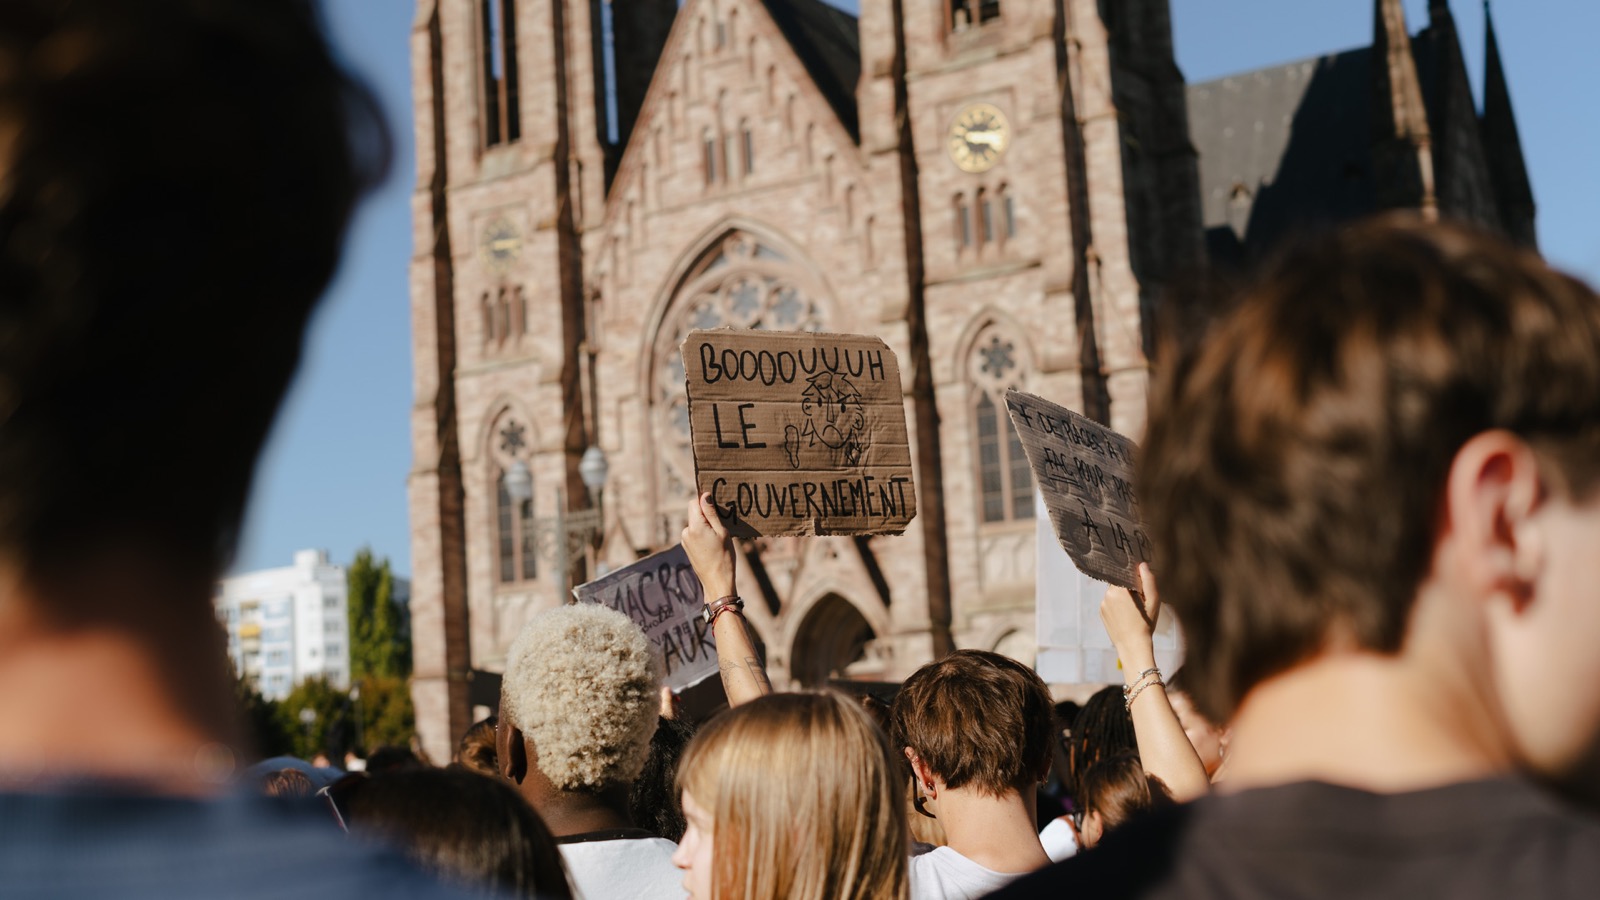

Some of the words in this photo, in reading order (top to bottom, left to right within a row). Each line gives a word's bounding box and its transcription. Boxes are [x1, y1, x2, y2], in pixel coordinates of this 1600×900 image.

[700, 342, 885, 386] BOOOOUUUH
[713, 403, 767, 449] LE
[1037, 411, 1063, 439] DE
[1063, 423, 1105, 456] PLACES
[1043, 446, 1074, 477] FAC
[1073, 456, 1110, 491] POUR
[712, 476, 909, 525] GOUVERNEMENT
[1077, 497, 1105, 547] À
[1108, 517, 1134, 556] LA
[592, 562, 700, 622] MACRO
